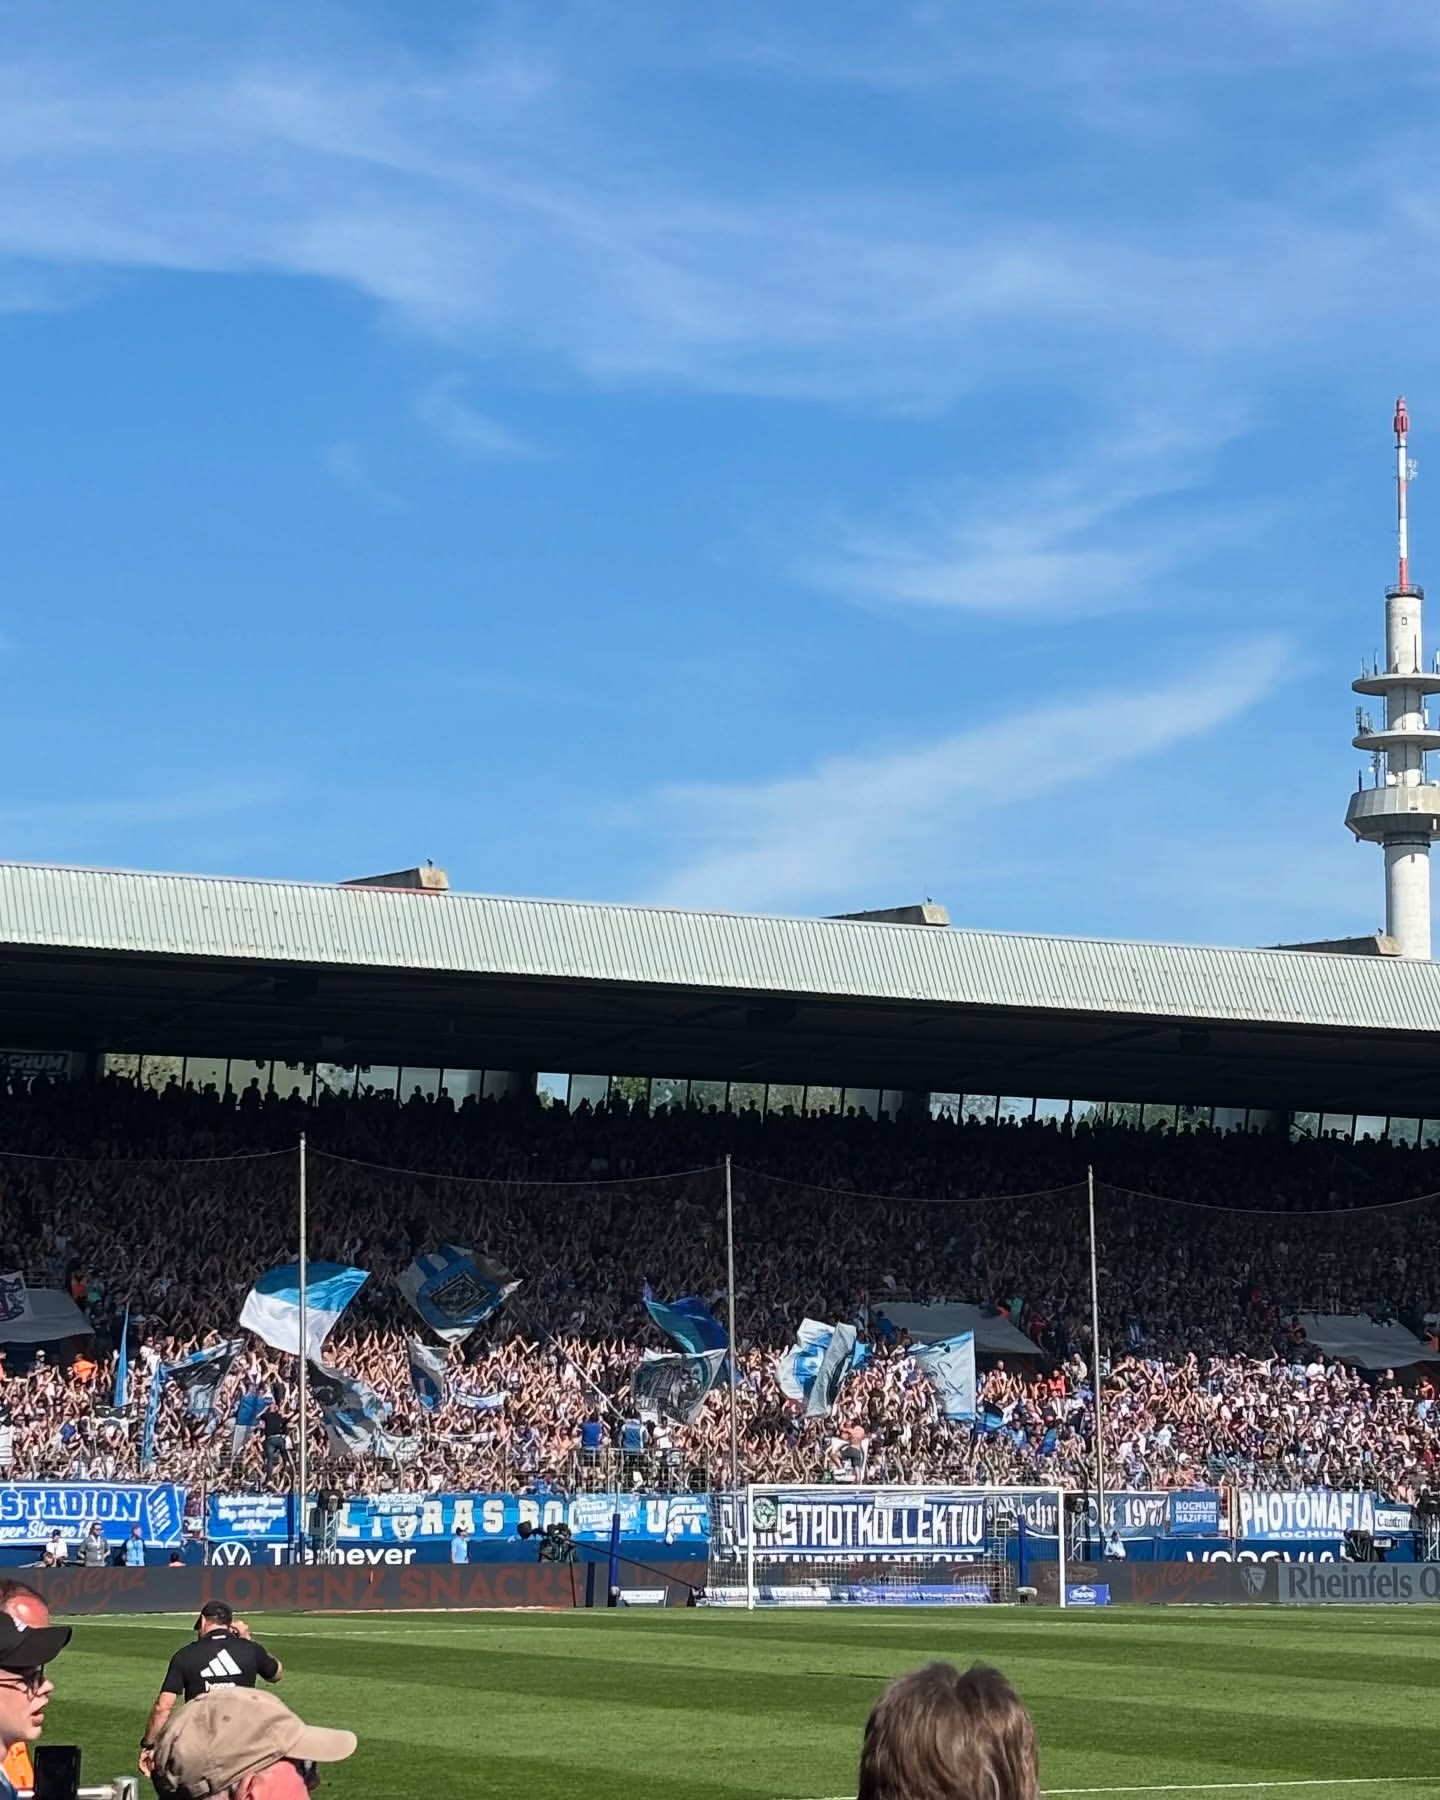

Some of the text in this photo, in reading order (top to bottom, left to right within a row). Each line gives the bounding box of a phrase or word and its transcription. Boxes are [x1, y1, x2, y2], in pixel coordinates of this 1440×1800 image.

[0, 1490, 142, 1521] STADION
[1175, 1500, 1217, 1510] BOCHUM
[1240, 1491, 1374, 1537] PHOTOMAFIA
[202, 1567, 583, 1607] LORENZ SNACKS
[1288, 1565, 1413, 1599] Rheinfels
